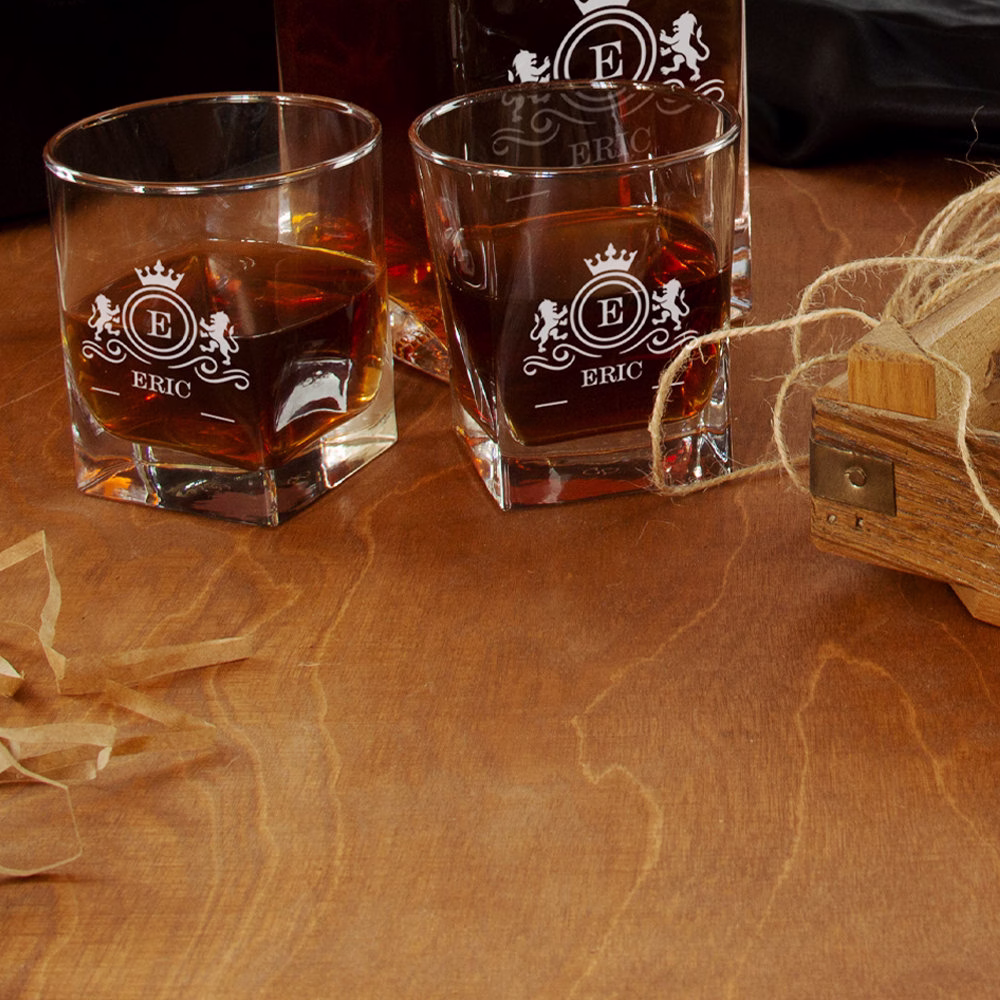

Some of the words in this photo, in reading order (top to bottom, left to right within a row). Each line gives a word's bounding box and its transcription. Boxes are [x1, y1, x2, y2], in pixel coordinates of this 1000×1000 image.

[589, 40, 623, 81] E
[569, 127, 651, 168] ERIC
[147, 309, 172, 339] E
[597, 297, 624, 328] E
[131, 370, 192, 399] ERIC
[581, 361, 643, 388] ERIC
